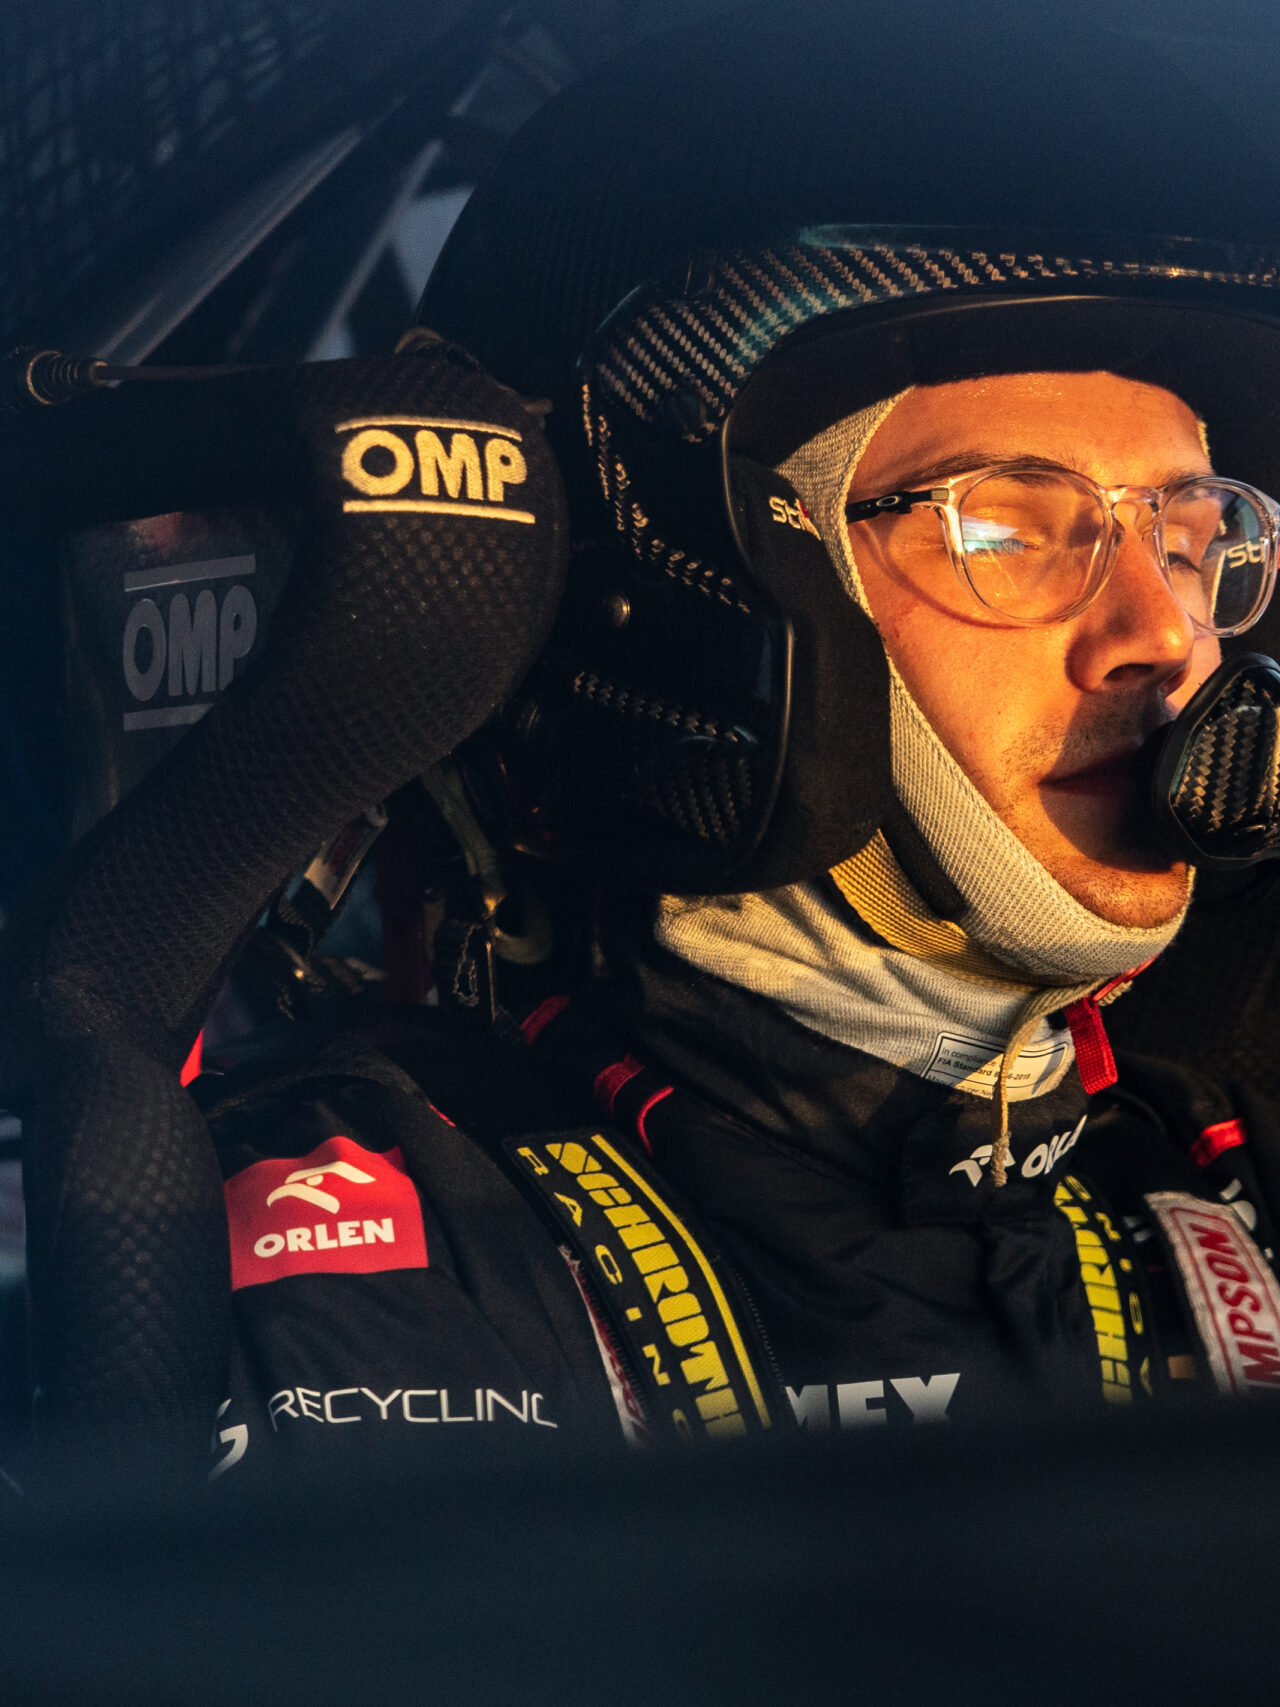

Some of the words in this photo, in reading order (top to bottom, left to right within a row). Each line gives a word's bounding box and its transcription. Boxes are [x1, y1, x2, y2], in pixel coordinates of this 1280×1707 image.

[341, 429, 527, 501] OMP
[122, 585, 257, 701] OMP
[937, 1057, 951, 1066] FIA
[953, 1061, 992, 1076] Standard
[254, 1218, 395, 1258] ORLEN
